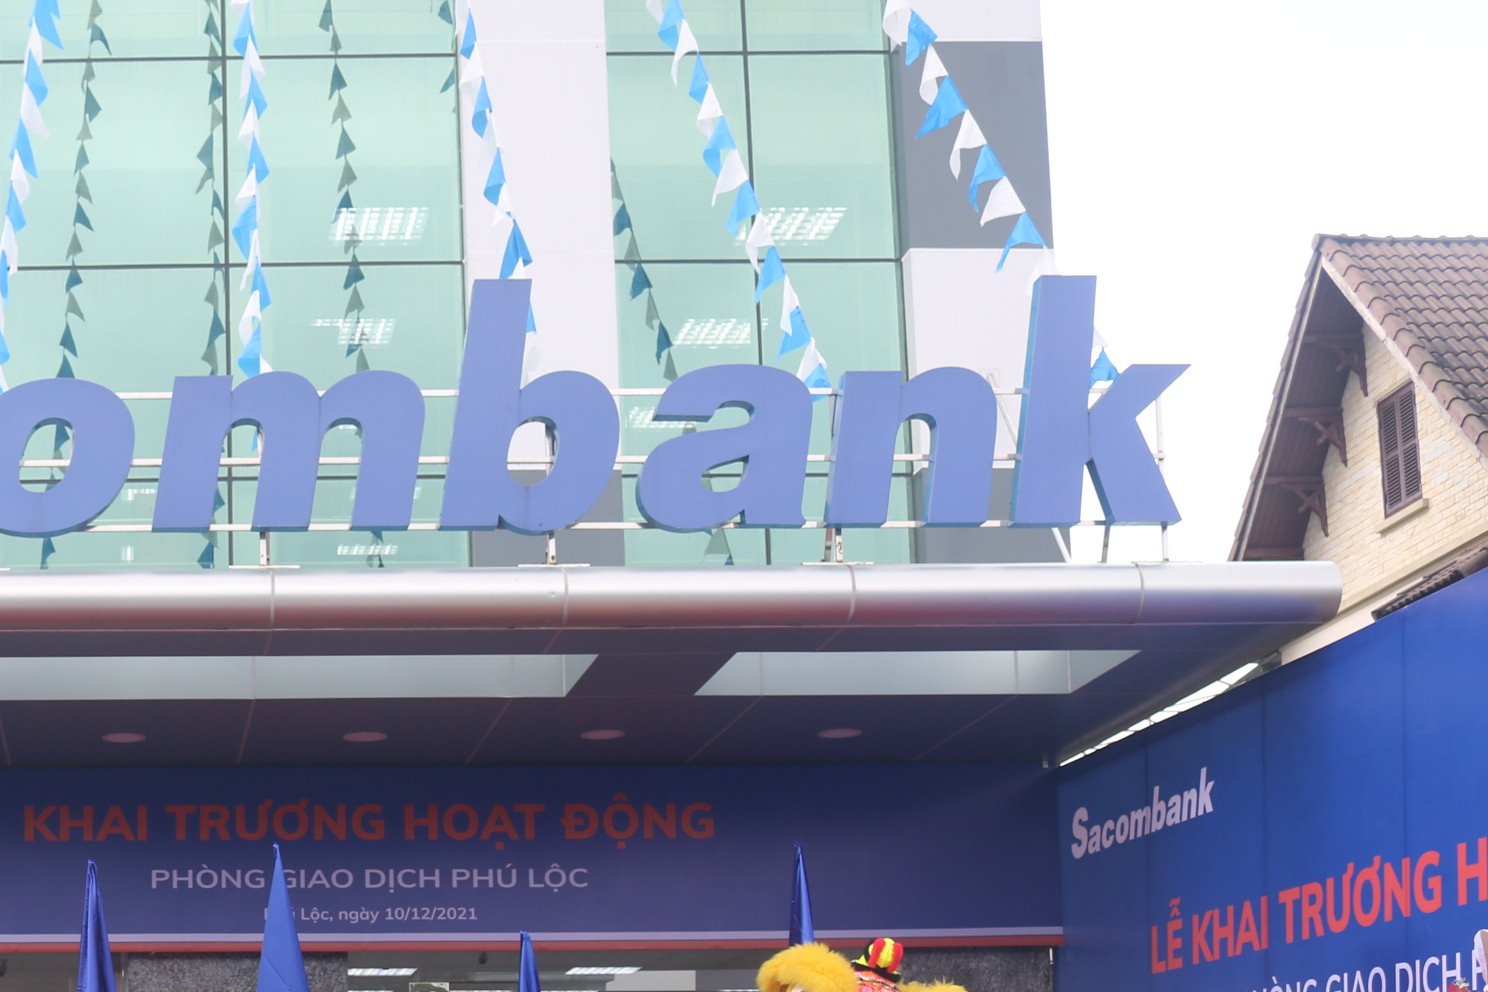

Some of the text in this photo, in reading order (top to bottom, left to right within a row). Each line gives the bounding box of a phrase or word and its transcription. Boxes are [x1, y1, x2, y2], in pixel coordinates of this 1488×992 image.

[23, 793, 715, 850] KHAI TRƯƠNG HOẠT ĐỘNG
[1071, 767, 1215, 860] Sacombank
[151, 864, 265, 889] PHÒNG
[364, 869, 441, 893] DỊCH
[451, 863, 518, 889] PHÚ
[528, 863, 589, 892] LỘC
[300, 907, 334, 923] Lộc,
[338, 907, 380, 924] ngày
[385, 907, 478, 922] 10/12/2021
[1150, 897, 1183, 975] LỄ
[1192, 896, 1269, 966] KHAI
[1278, 850, 1442, 945] TRƯƠNG
